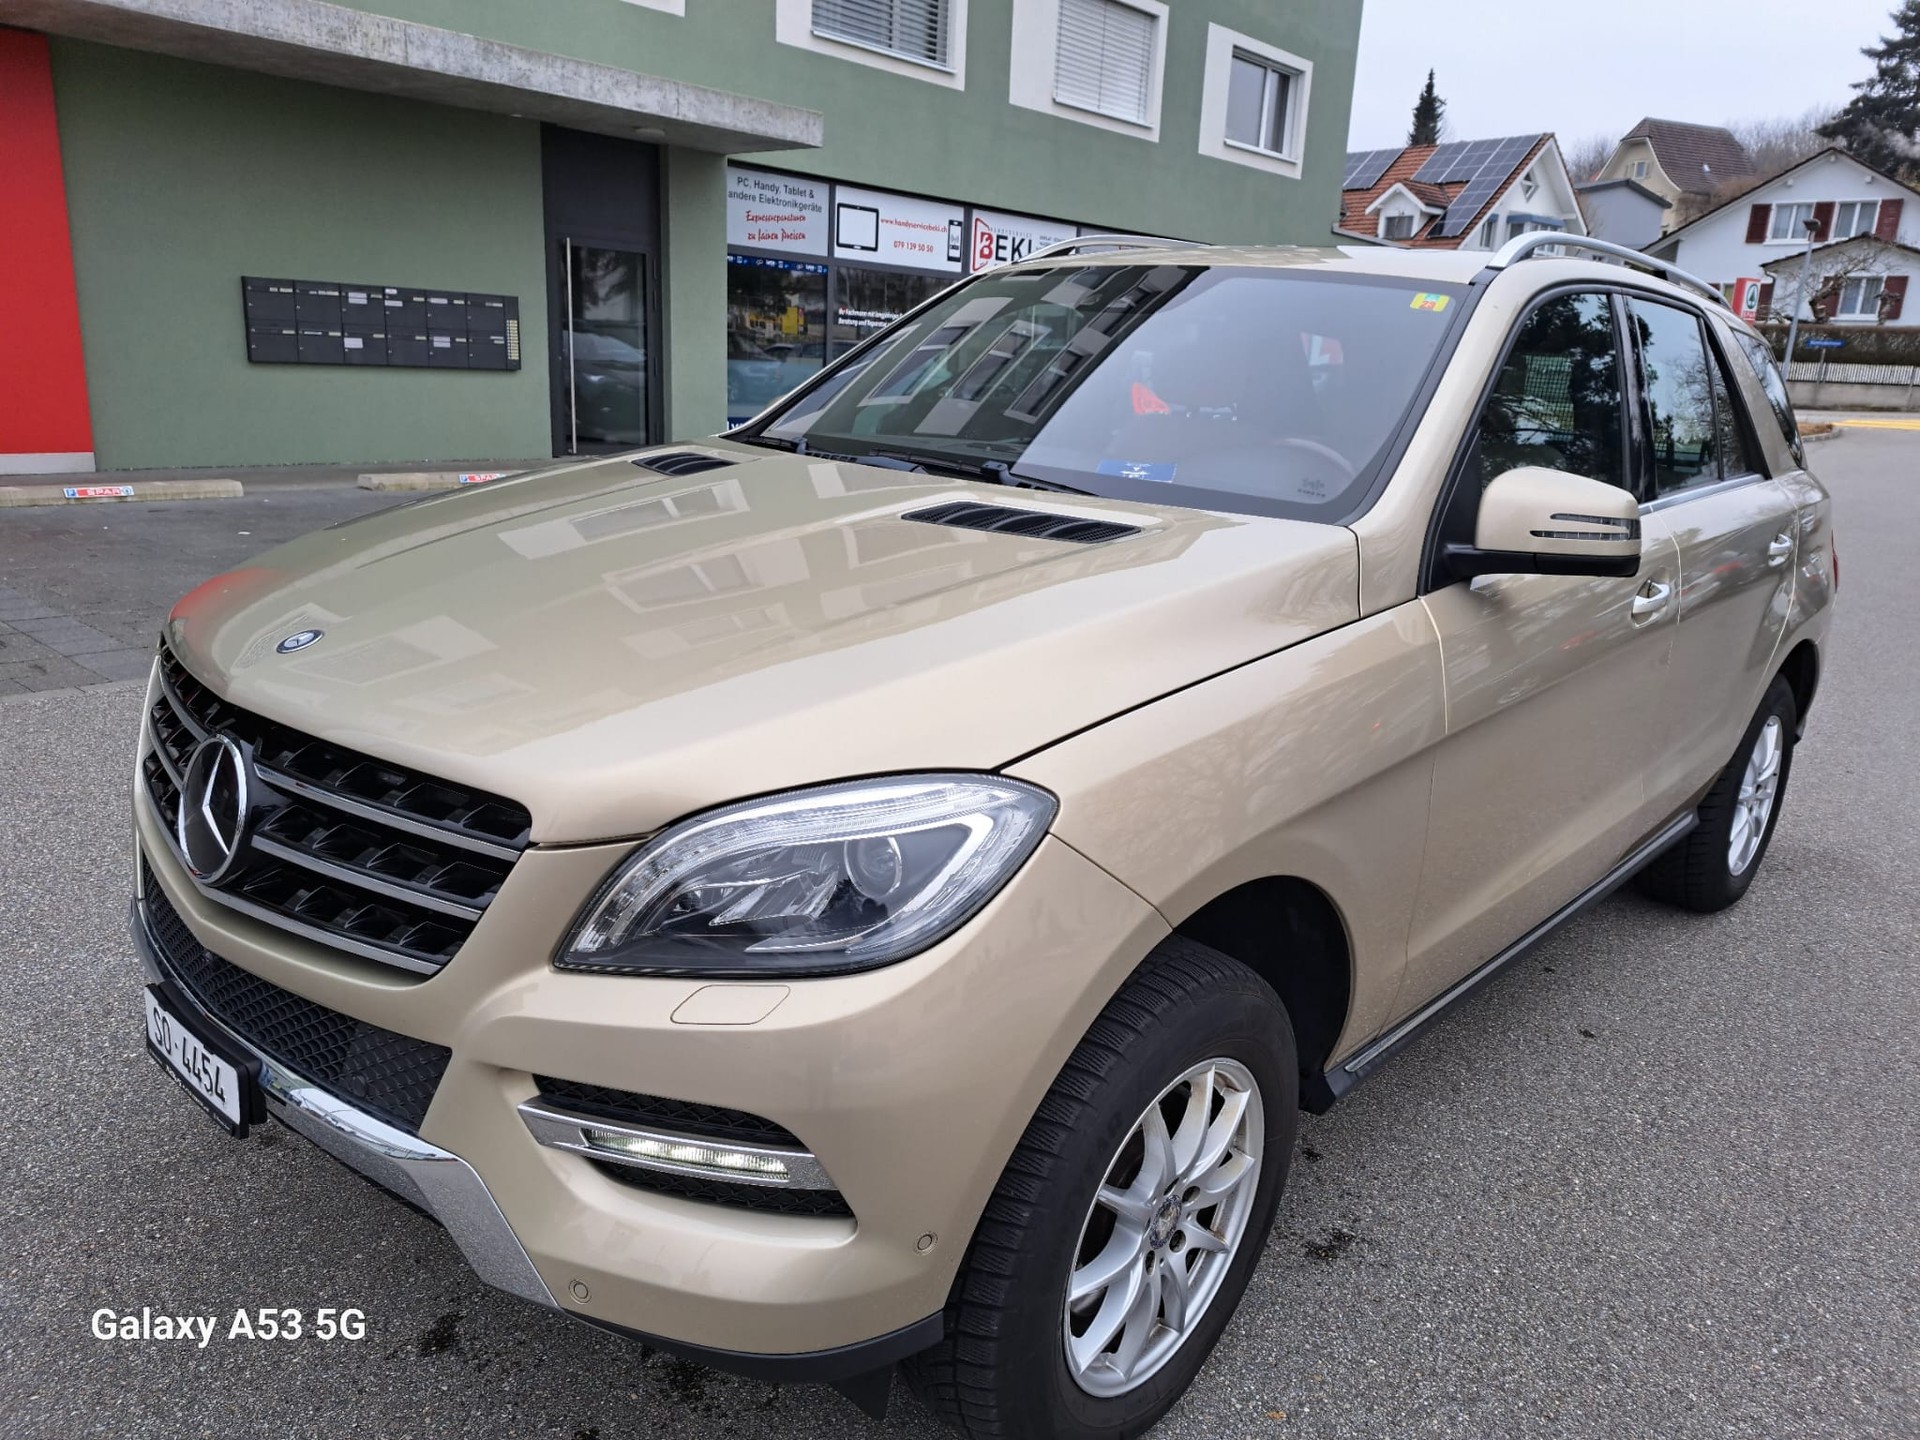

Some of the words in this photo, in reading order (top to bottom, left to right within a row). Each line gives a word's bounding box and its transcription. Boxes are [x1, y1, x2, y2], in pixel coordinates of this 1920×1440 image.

[737, 176, 752, 190] PC,
[754, 180, 781, 195] Handy,
[783, 184, 807, 198] Tablet
[808, 189, 815, 199] &
[728, 190, 757, 202] andere
[758, 193, 822, 213] Elektronikgeräte
[880, 218, 948, 233] www.handyservicebeki.ch
[781, 228, 806, 242] Preisen
[893, 240, 905, 249] 079
[917, 243, 926, 252] 50
[926, 244, 934, 253] 50
[979, 231, 1032, 262] BEKI
[87, 488, 120, 496] SPAR
